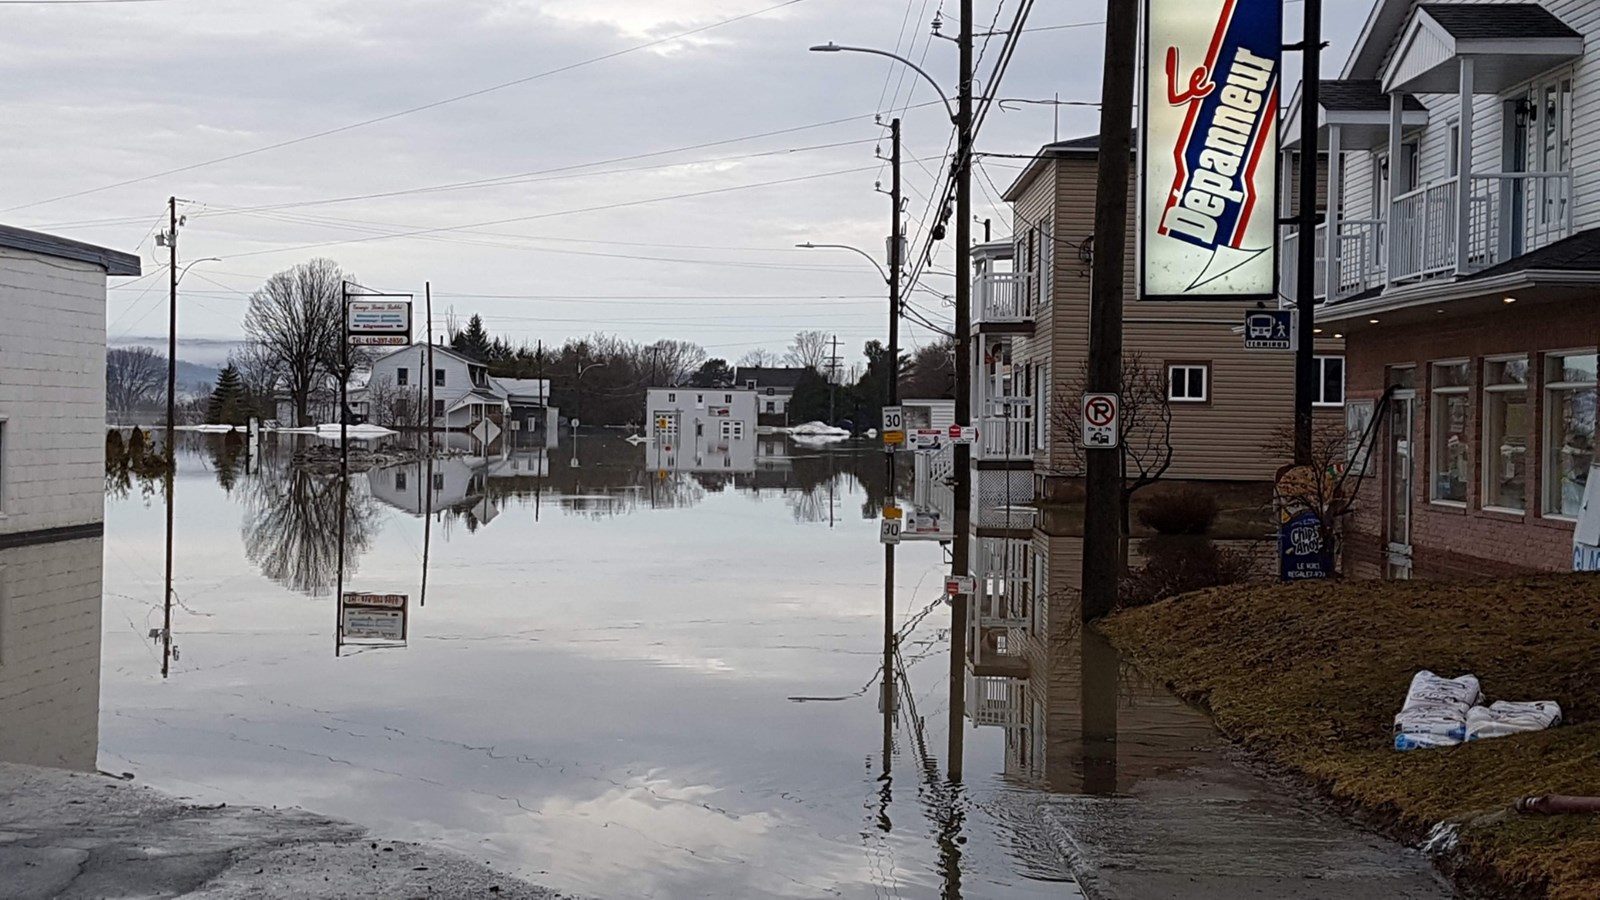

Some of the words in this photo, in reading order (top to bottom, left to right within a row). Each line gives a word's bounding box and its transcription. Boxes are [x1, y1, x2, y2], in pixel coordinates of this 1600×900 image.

[1166, 46, 1215, 106] Le
[1163, 47, 1275, 245] Dépanneur
[885, 414, 900, 428] 30
